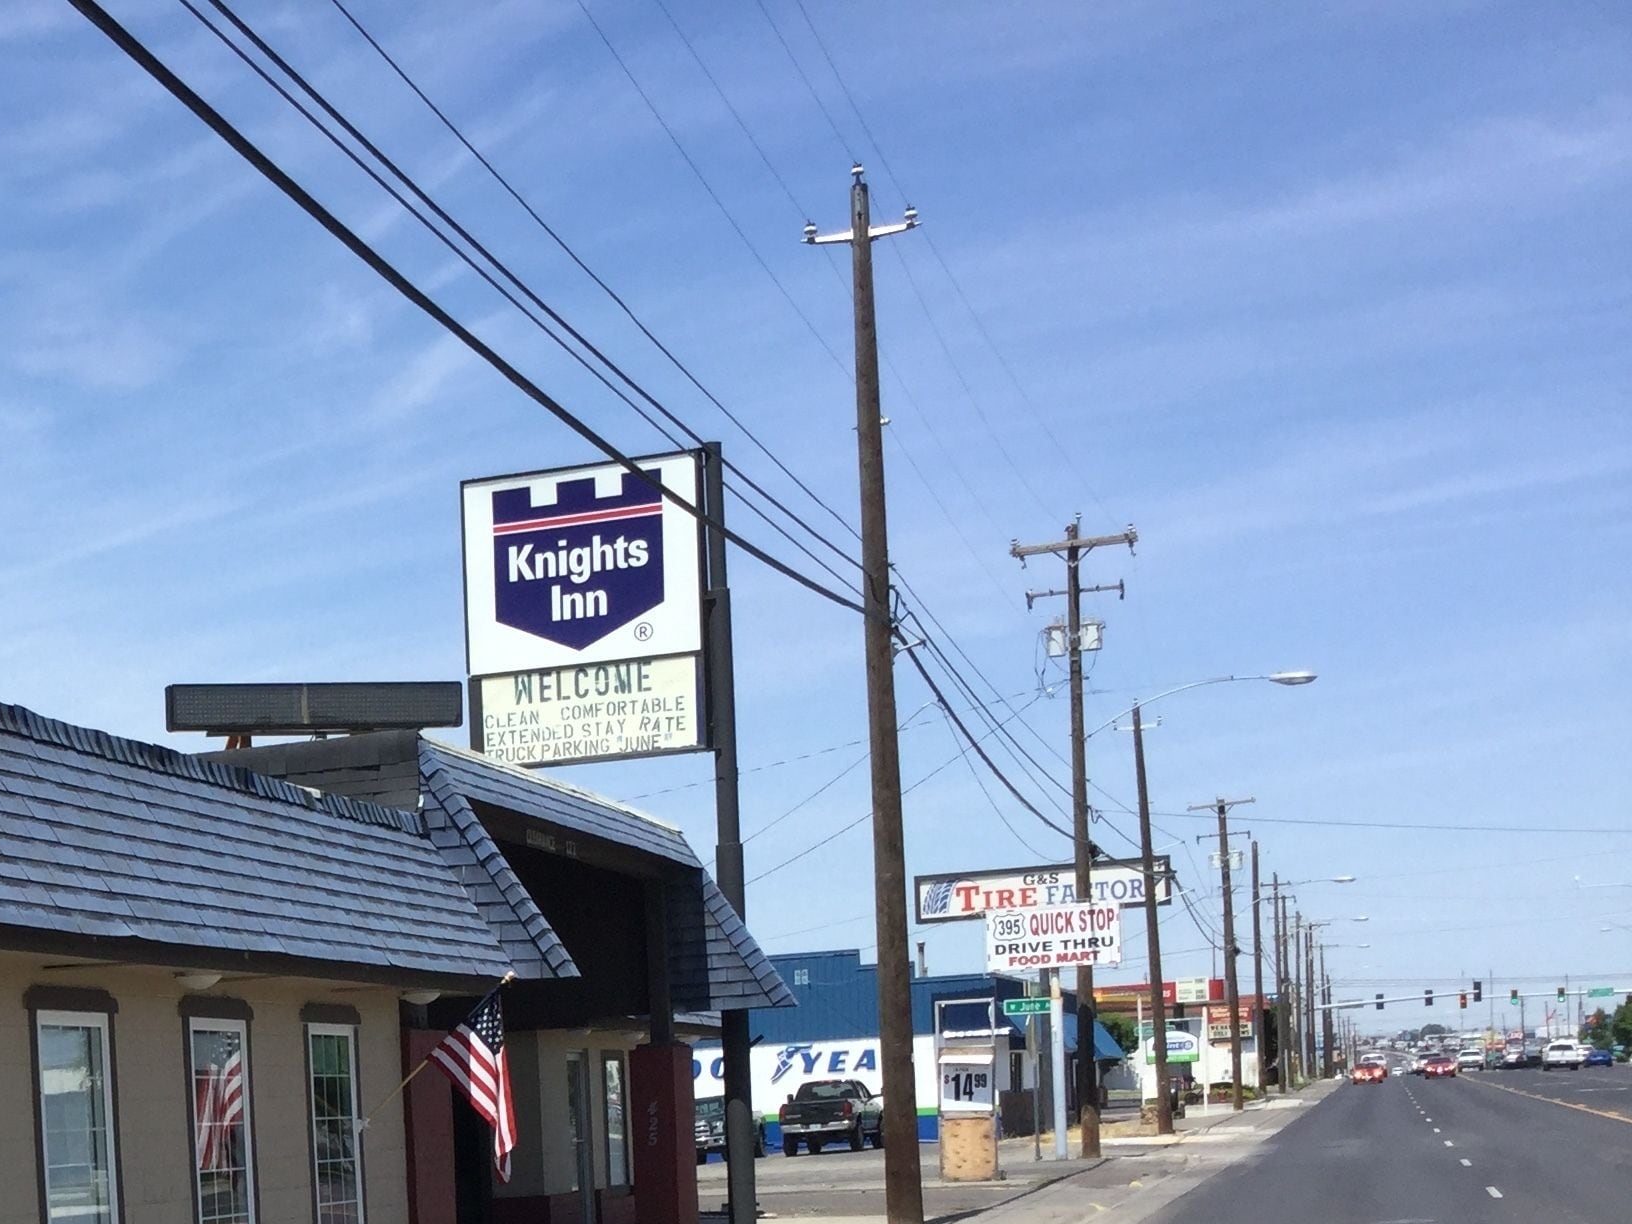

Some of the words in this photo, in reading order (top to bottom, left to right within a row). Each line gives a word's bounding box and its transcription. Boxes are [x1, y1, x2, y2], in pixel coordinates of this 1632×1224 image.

[508, 535, 649, 584] Knights
[551, 585, 608, 622] Inn
[514, 662, 653, 705] WELCOME
[485, 710, 539, 729] CLEAN
[561, 695, 685, 721] COMFORTABLE
[486, 723, 574, 747] EXTENDED
[581, 719, 626, 738] STAY
[639, 715, 686, 733] RATE
[542, 738, 610, 762] PARKING
[1023, 872, 1059, 886] G&S
[956, 885, 1037, 912] TIRE
[998, 919, 1021, 936] 395
[1030, 911, 1074, 936] QUICK
[1079, 908, 1115, 932] STOP
[995, 941, 1053, 955] DRIVE
[1061, 936, 1114, 950] THRU
[1009, 955, 1051, 967] FOOD
[1056, 950, 1101, 963] MART
[800, 1049, 877, 1074] YEA
